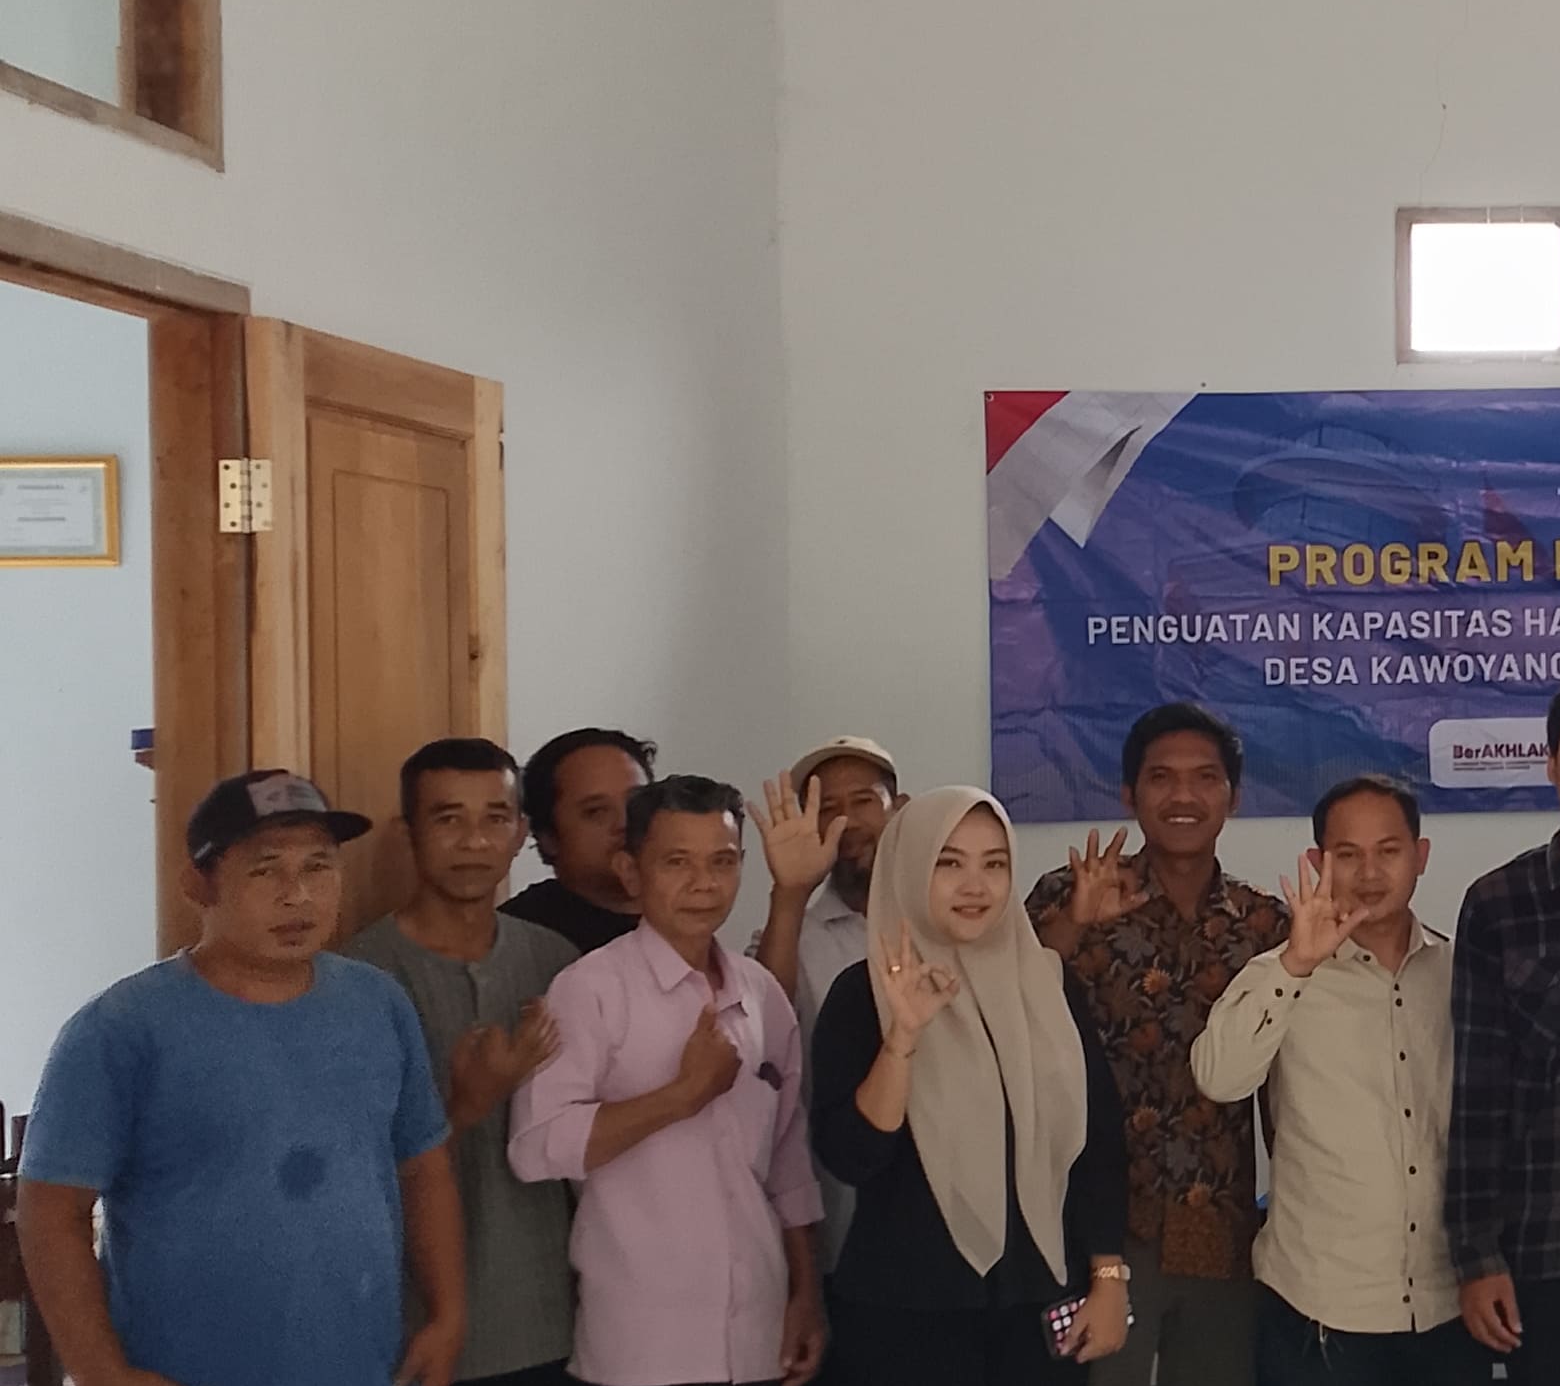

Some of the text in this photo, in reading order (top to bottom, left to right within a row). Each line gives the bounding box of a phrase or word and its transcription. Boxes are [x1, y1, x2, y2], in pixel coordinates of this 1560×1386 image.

[1267, 540, 1534, 586] PROGRAM
[1087, 612, 1301, 645] PENGUATAN
[1312, 609, 1513, 641] KAPASITAS
[1264, 657, 1358, 685] DESA
